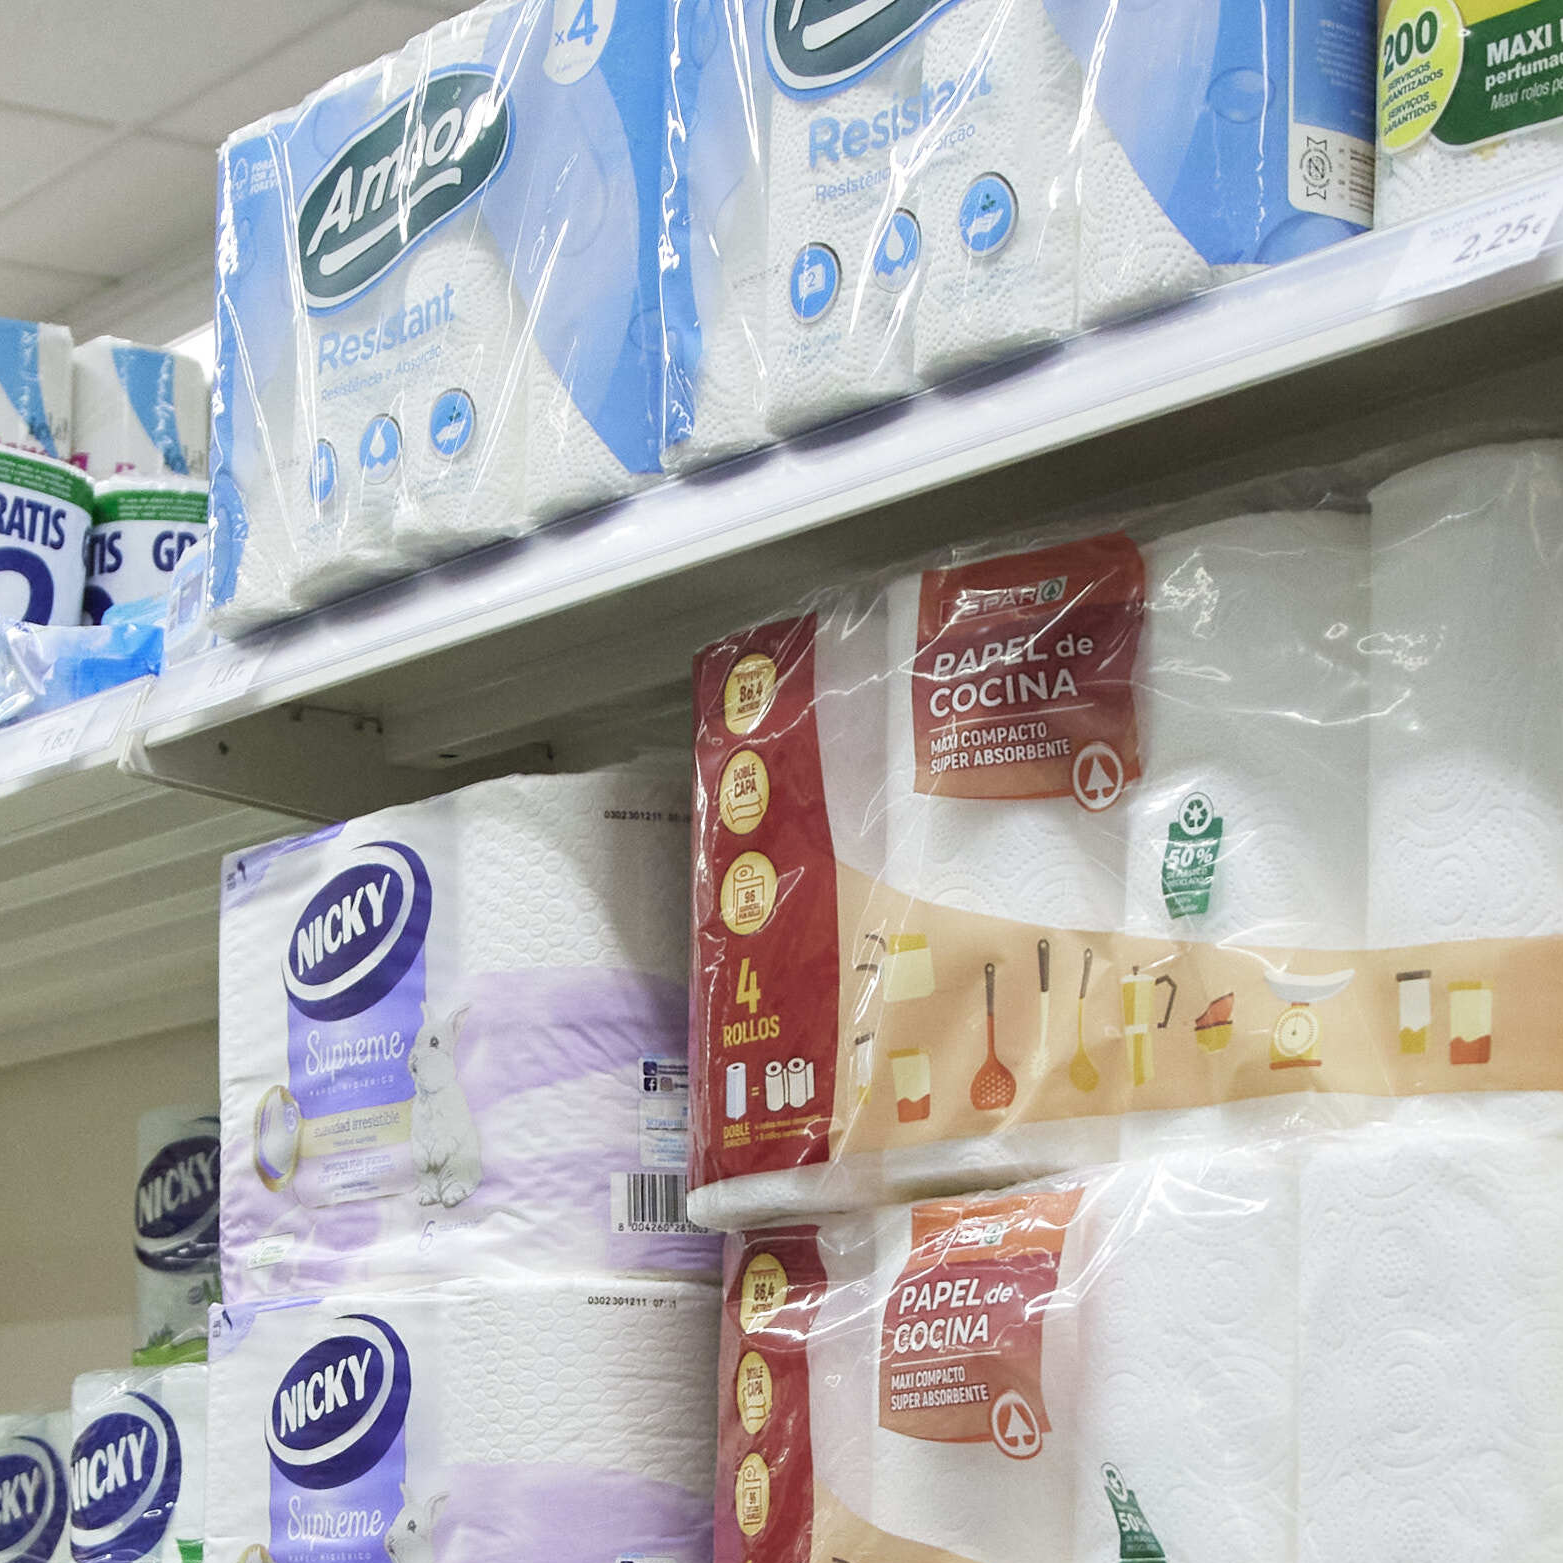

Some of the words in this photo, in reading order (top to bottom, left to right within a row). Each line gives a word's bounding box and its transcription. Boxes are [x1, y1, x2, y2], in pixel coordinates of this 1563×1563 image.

[1382, 10, 1437, 79] 200
[1486, 20, 1552, 67] MAXI
[1388, 62, 1431, 92] SERVICIOS
[1490, 86, 1519, 111] Maxi
[1520, 78, 1549, 101] rolos
[317, 283, 455, 373] Resistant
[932, 634, 1048, 679] PAPEL
[1054, 633, 1094, 658] de
[929, 667, 1079, 720] COCINA
[929, 749, 970, 776] SUPER
[974, 738, 1072, 767] ABSORBENTE
[930, 729, 960, 756] MAXI
[961, 721, 1048, 749] COMPACTO
[732, 761, 758, 783] DOBLE
[733, 776, 759, 799] CAPA
[1165, 847, 1214, 873] 50%
[295, 872, 392, 977] NICKY
[735, 957, 762, 1015] 4
[722, 1014, 781, 1050] ROLLOS
[305, 1030, 405, 1083] Supreme
[138, 1146, 219, 1228] NICKY
[898, 1278, 982, 1316] PAPEL
[987, 1282, 1014, 1305] de
[893, 1313, 989, 1354] COCINA
[279, 1346, 371, 1438] NICKY
[891, 1372, 914, 1391] MAXI
[915, 1365, 966, 1388] COMPACTO
[891, 1392, 920, 1411] SUPER
[921, 1383, 989, 1407] ABSORBENTE
[287, 1494, 386, 1551] Supreme
